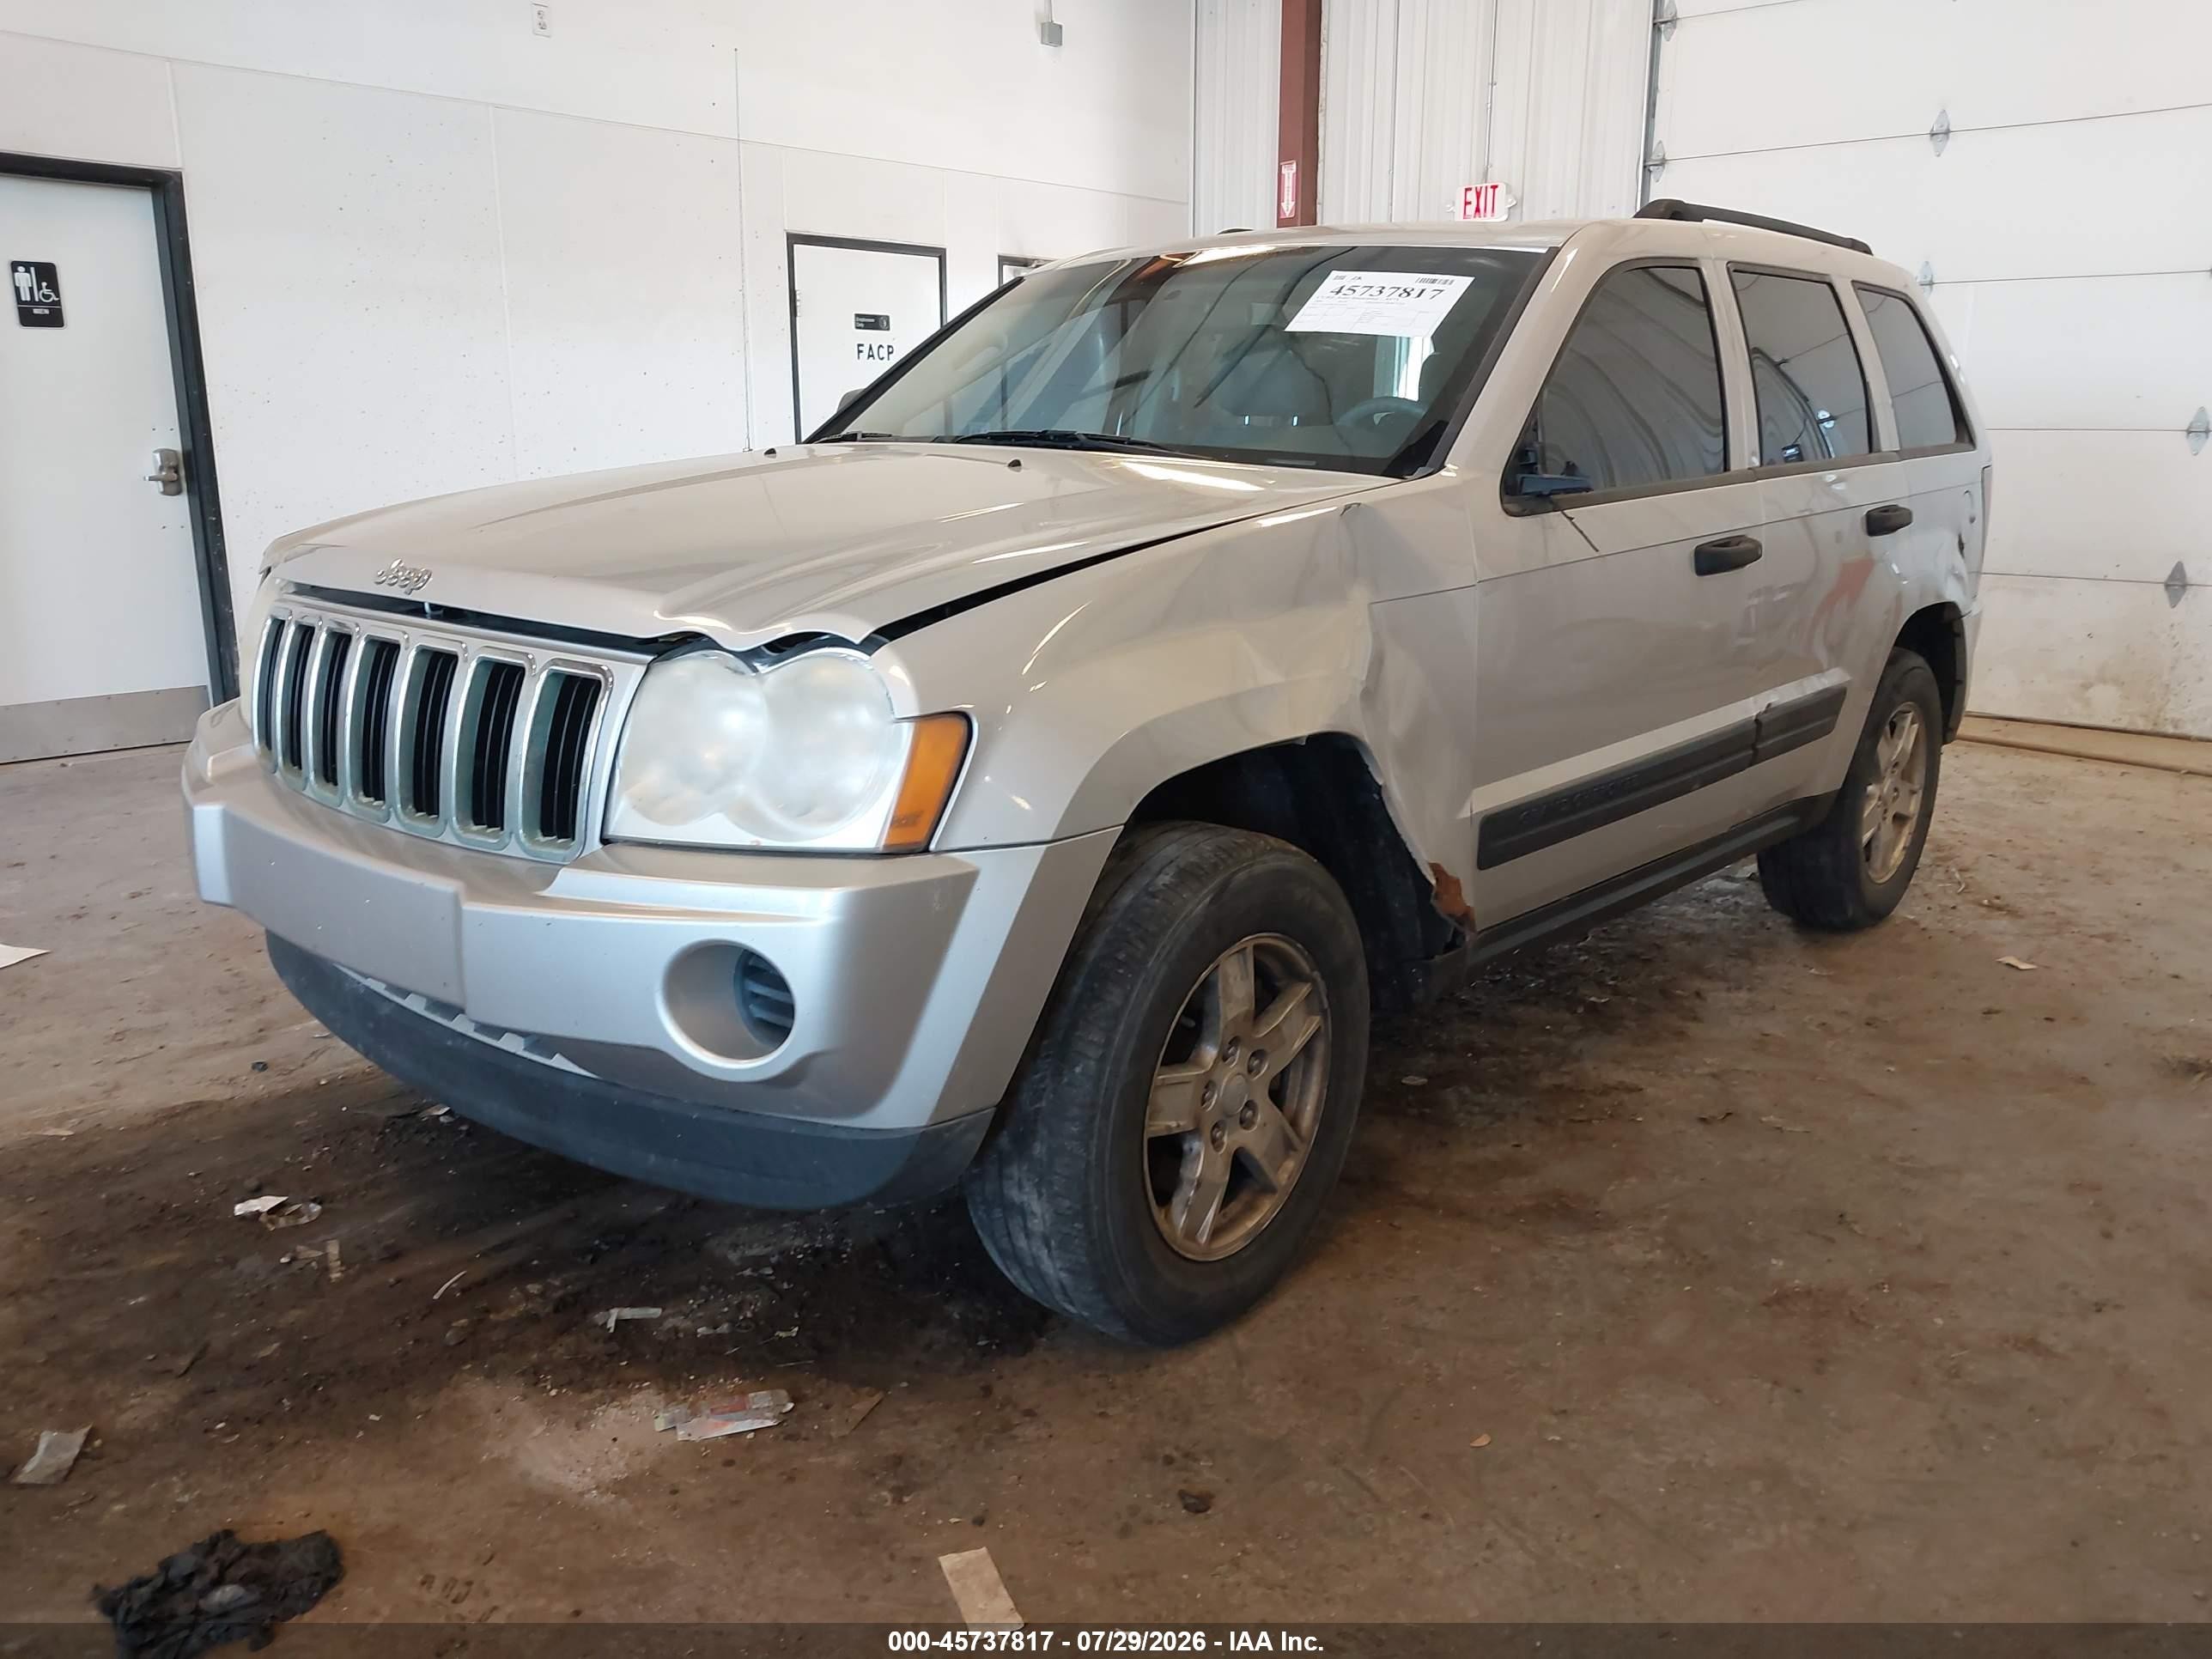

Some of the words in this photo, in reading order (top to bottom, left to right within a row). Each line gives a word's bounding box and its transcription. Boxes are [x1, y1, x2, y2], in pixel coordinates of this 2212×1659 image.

[1463, 185, 1498, 219] EXIT
[1329, 284, 1445, 301] 45737817
[857, 343, 894, 361] FACP
[374, 558, 433, 595] Jeep
